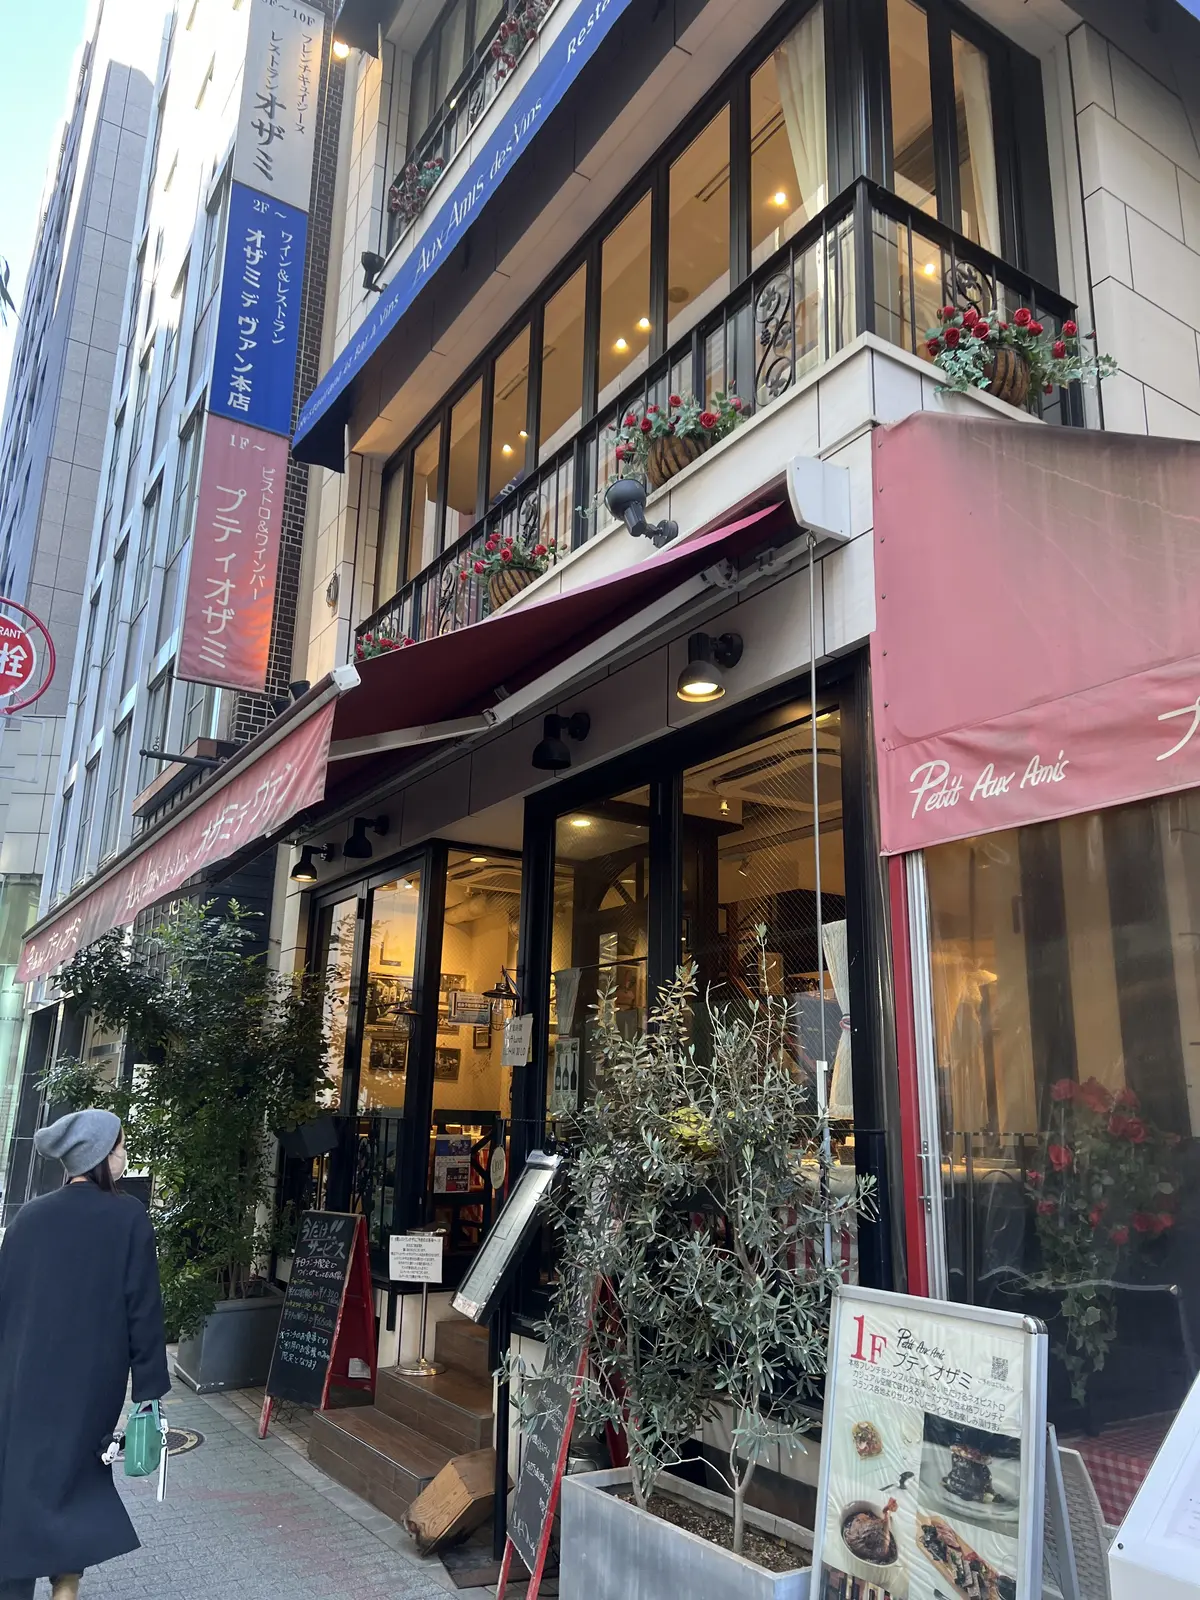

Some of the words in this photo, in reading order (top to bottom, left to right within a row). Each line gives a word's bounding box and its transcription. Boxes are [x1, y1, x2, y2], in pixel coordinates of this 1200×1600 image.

[413, 228, 444, 282] Aux
[446, 175, 485, 238] Amis
[489, 140, 513, 181] des
[513, 97, 543, 144] Vins
[198, 485, 248, 669] プティオザミ
[909, 759, 964, 819] Petit
[969, 762, 1016, 802] Aux
[1019, 750, 1070, 790] Amis
[307, 1240, 346, 1260] サービス
[850, 1314, 887, 1365] 1F
[897, 1328, 915, 1350] Petit
[893, 1352, 972, 1390] プティオザミ
